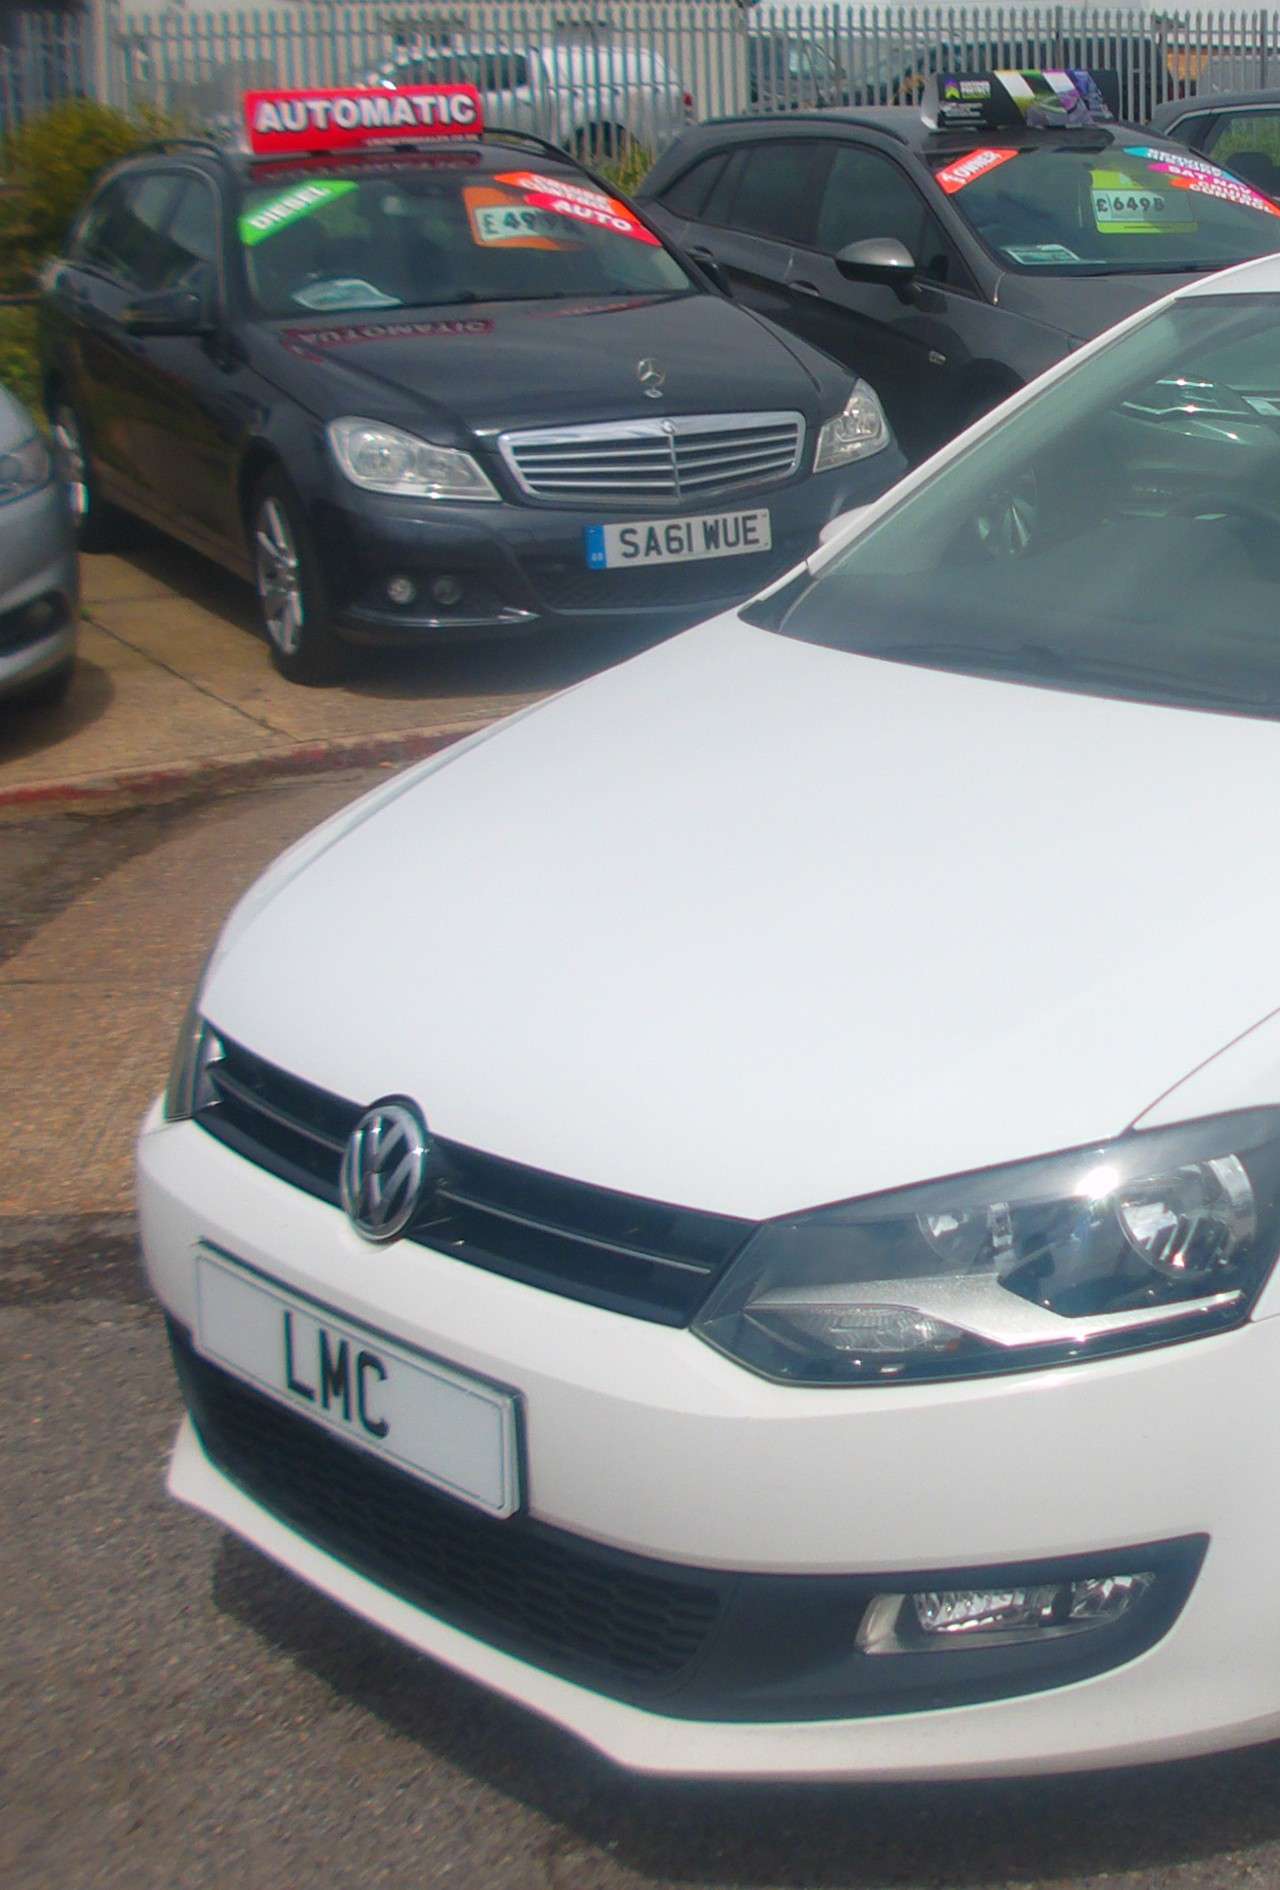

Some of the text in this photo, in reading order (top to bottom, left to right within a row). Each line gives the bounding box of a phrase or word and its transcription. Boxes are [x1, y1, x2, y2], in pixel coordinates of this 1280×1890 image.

[255, 94, 477, 132] AUTOMATIC
[1168, 165, 1206, 181] SAT
[552, 200, 633, 232] AUTO
[619, 514, 760, 558] SA61 WUE
[283, 1309, 390, 1440] LMC
